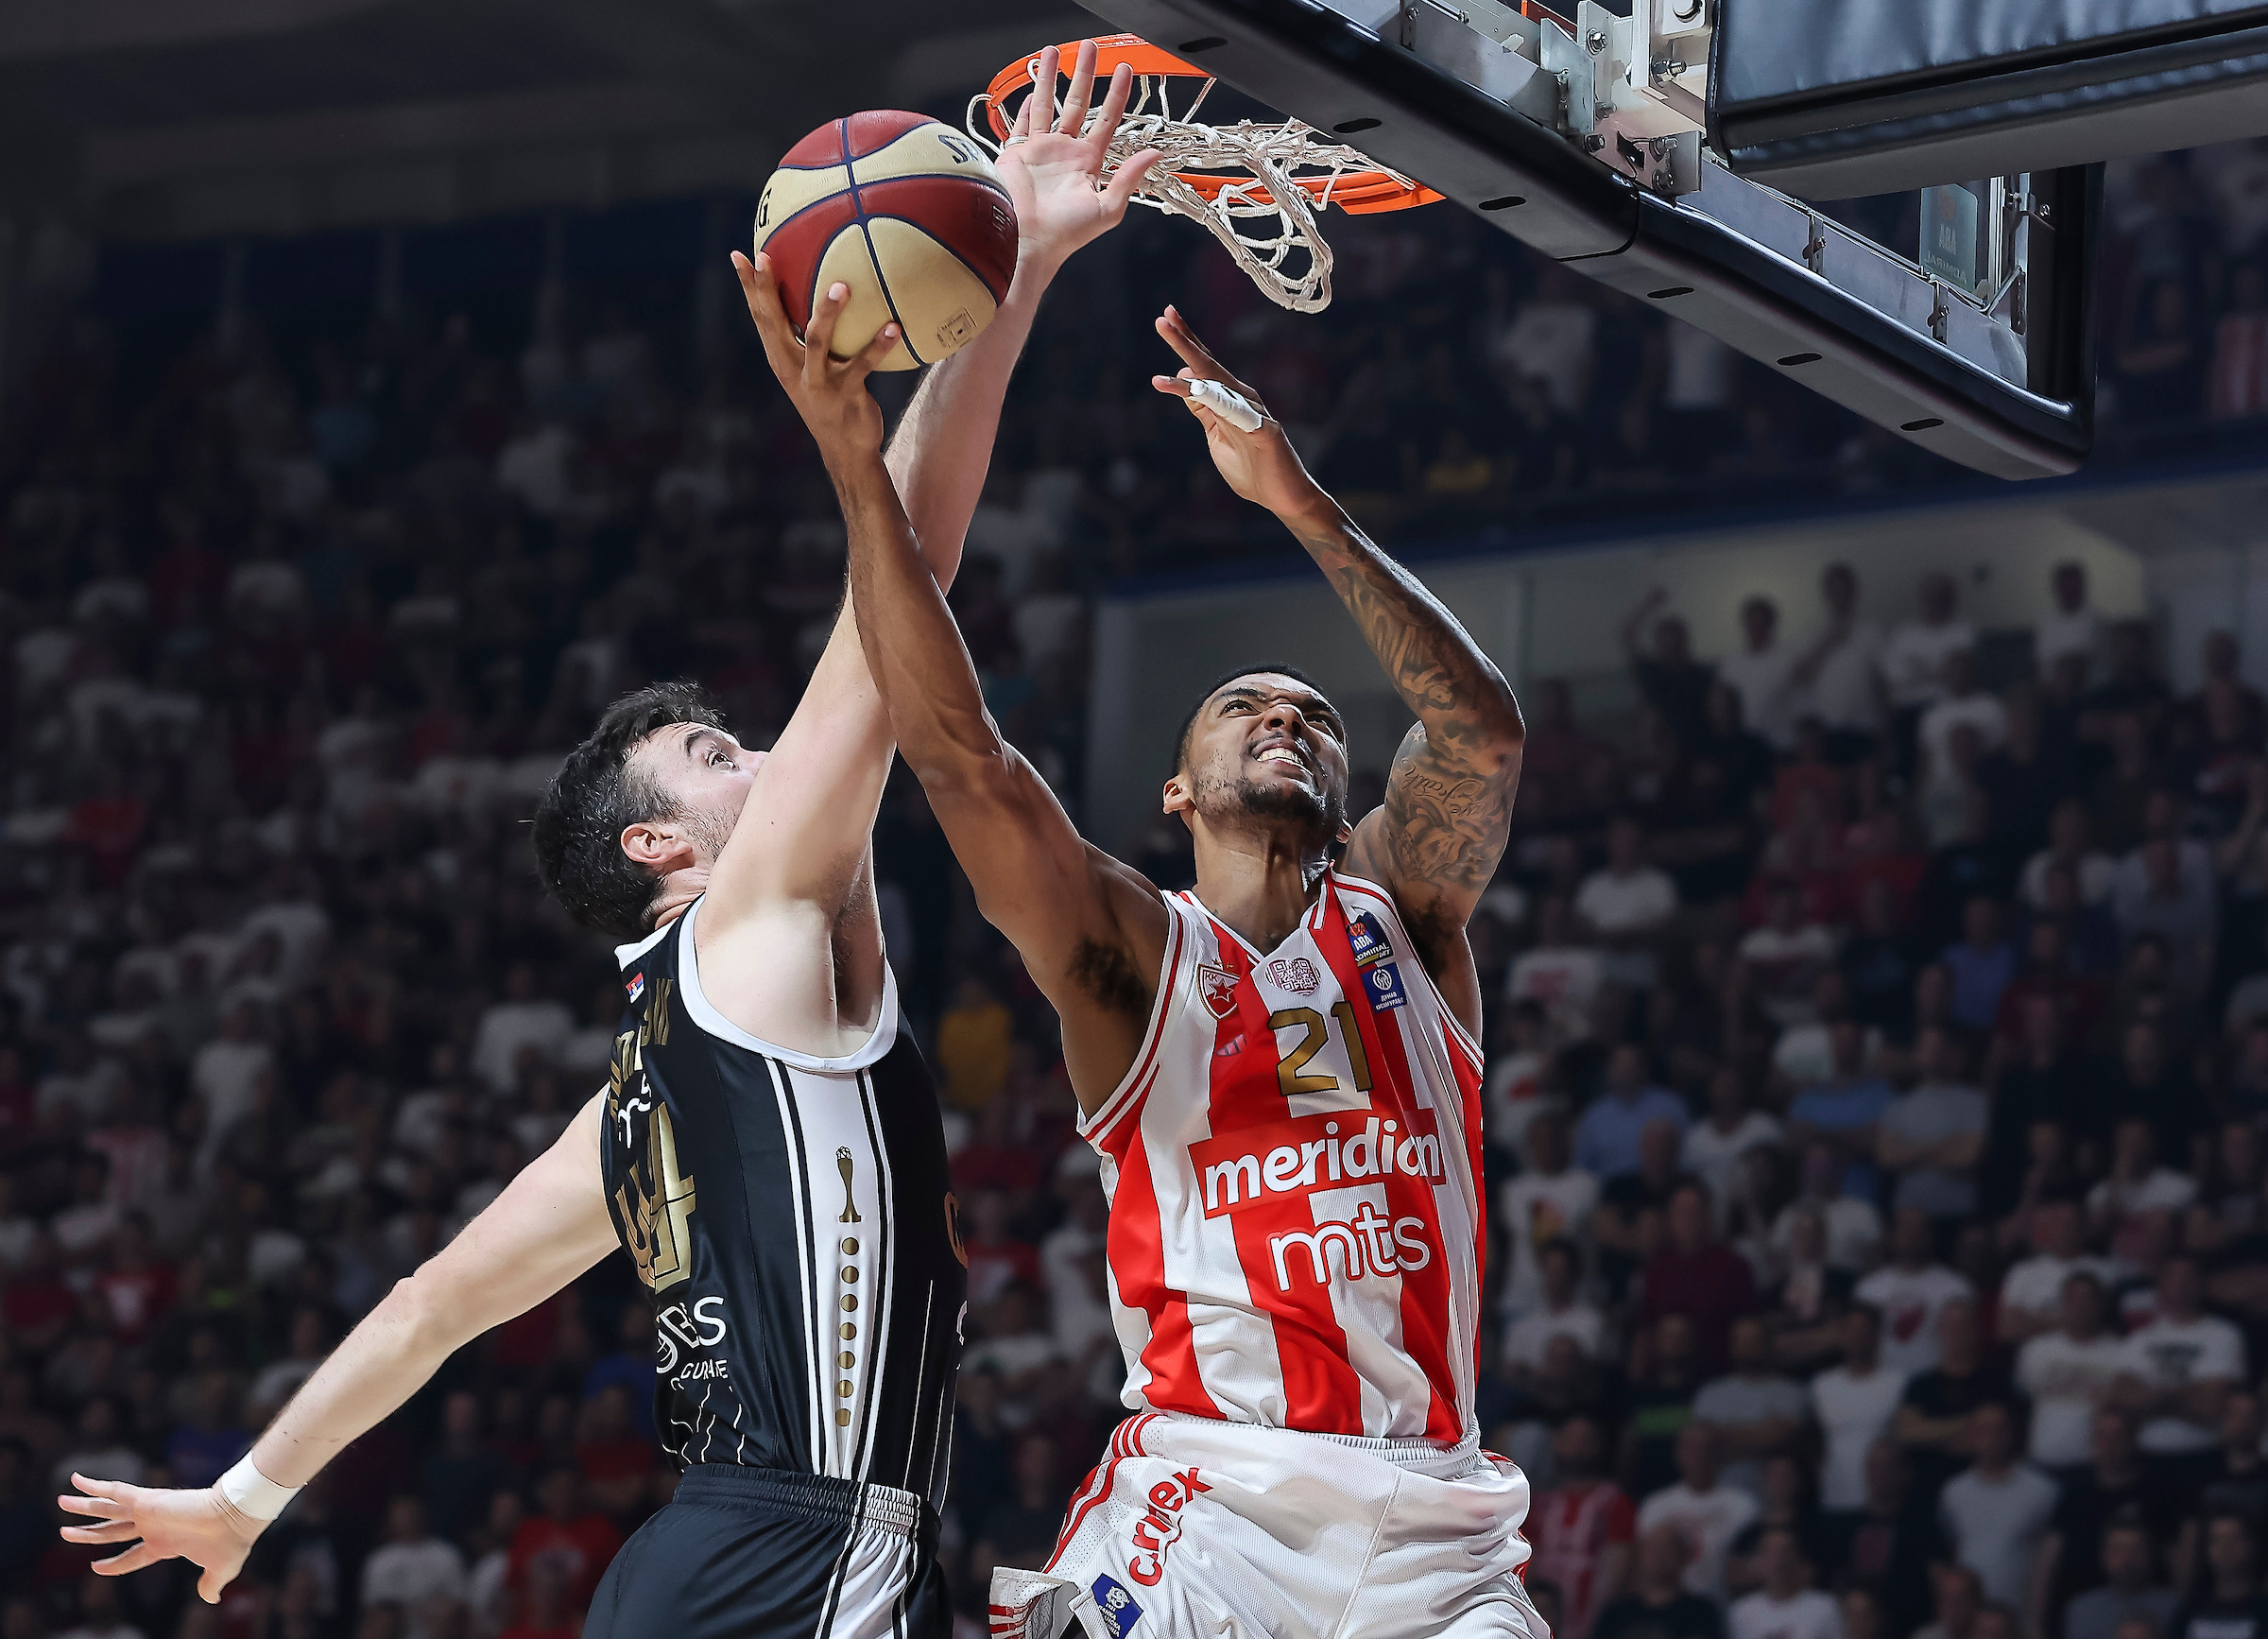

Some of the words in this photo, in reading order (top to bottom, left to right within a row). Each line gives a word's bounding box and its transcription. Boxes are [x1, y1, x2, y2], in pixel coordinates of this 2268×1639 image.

[1353, 934, 1374, 951] ABA
[1267, 1000, 1374, 1096] 21
[1205, 1116, 1441, 1211] meridian
[1269, 1203, 1431, 1292] mts
